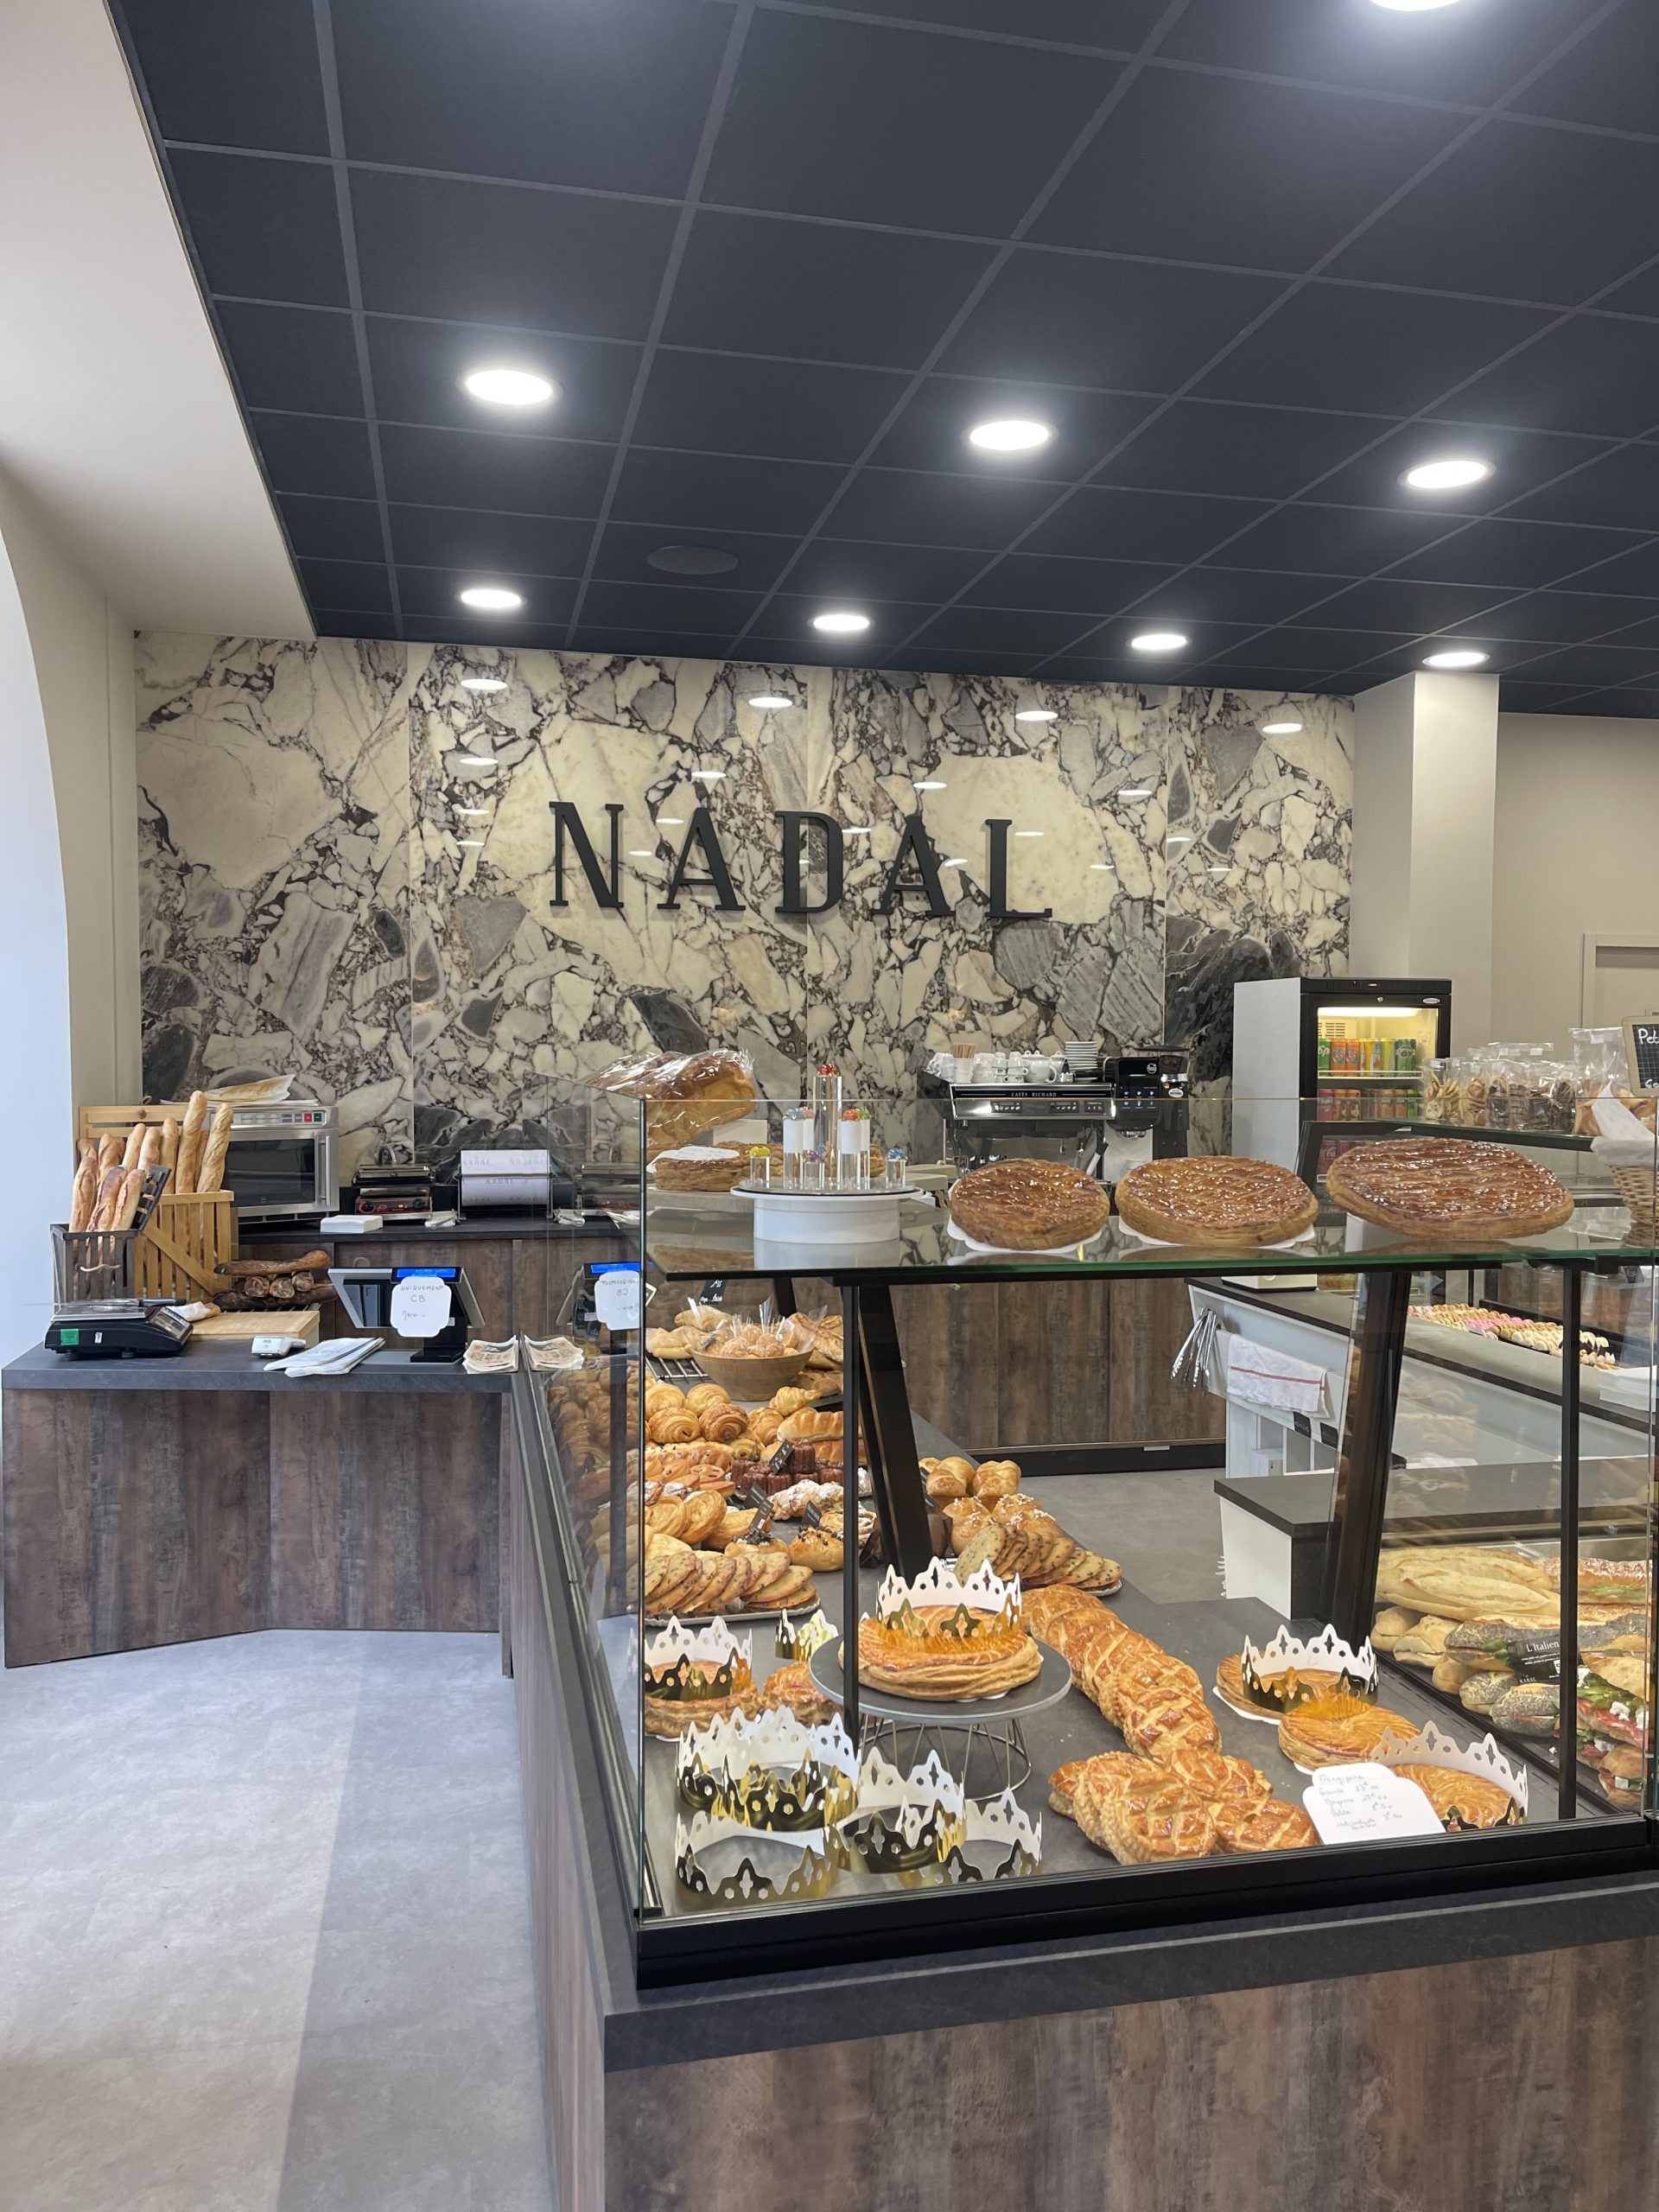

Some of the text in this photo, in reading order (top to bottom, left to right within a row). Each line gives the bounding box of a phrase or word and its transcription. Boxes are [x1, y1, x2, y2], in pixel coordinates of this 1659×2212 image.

[549, 801, 1052, 918] NADAL
[410, 1294, 426, 1303] CB
[1526, 1641, 1560, 1652] L'Italien
